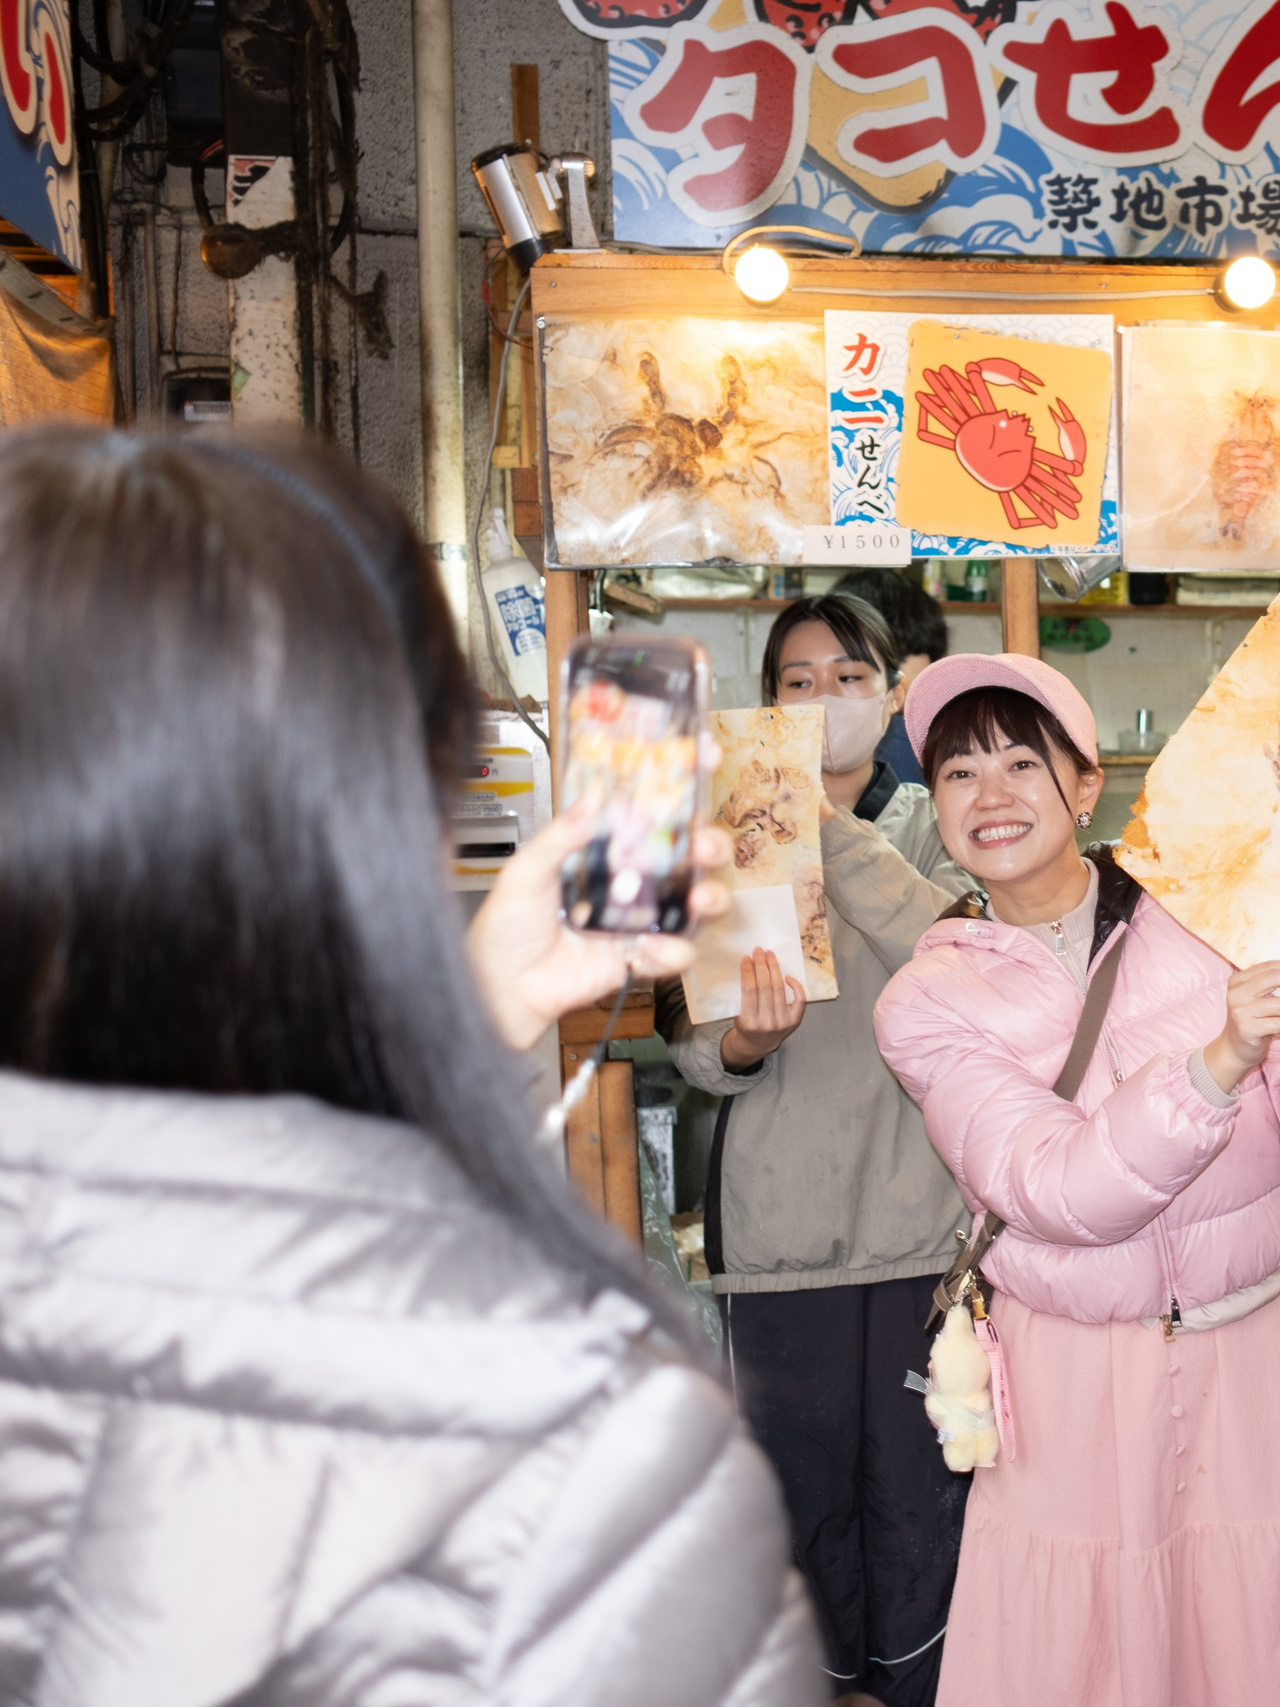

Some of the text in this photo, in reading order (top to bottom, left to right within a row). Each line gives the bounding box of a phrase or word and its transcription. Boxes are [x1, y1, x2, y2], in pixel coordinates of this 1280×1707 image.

[841, 332, 885, 528] カニせんべ
